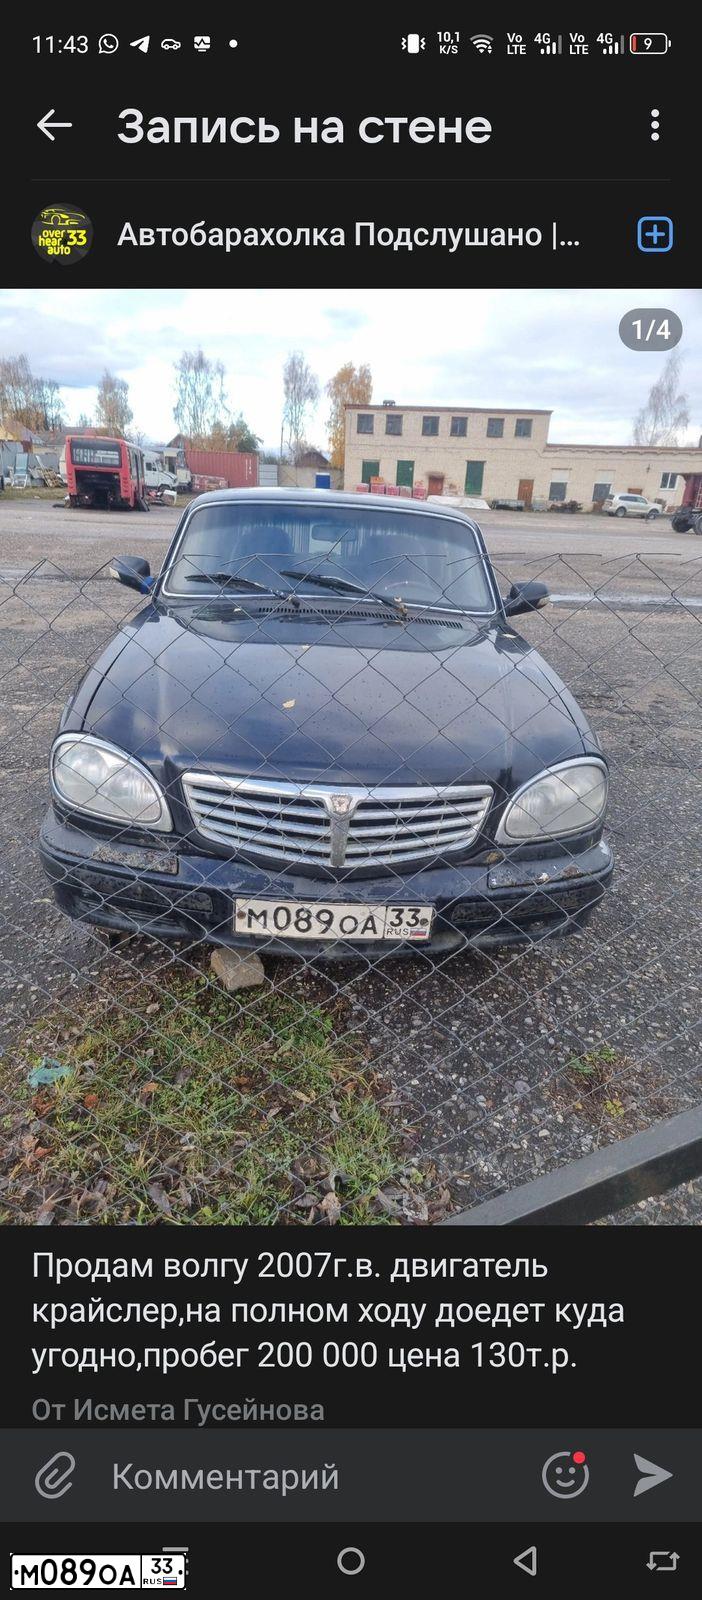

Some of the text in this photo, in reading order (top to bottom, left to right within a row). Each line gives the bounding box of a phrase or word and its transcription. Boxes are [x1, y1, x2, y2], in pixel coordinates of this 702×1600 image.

[436, 31, 460, 44] 10,1
[507, 32, 523, 44] Vo
[534, 32, 551, 44] 4G
[569, 32, 586, 44] Vo
[596, 32, 613, 44] 4G
[32, 35, 89, 54] 11:43
[439, 45, 459, 55] K/S
[507, 45, 527, 55] LTE
[569, 45, 589, 55] LTE
[643, 38, 653, 51] 9
[117, 108, 493, 144] Запись на стене
[42, 229, 65, 238] over
[67, 229, 87, 246] 33
[117, 221, 346, 252] Автобарахолка
[356, 222, 543, 252] Подслушано
[38, 235, 62, 246] hear
[47, 245, 71, 255] auto
[631, 319, 671, 341] 1/4
[389, 908, 420, 928] 33
[386, 928, 409, 936] RUS
[33, 1252, 549, 1285] Продам волгу 2007г.в. двигатель
[33, 1297, 625, 1330] крайслер,на полном ходу доедет куда
[32, 1340, 577, 1374] угодно,пробег 200 000 цена 130т.р.
[32, 1398, 325, 1427] От Исмета Гусейнова
[113, 1464, 339, 1497] Комментарий
